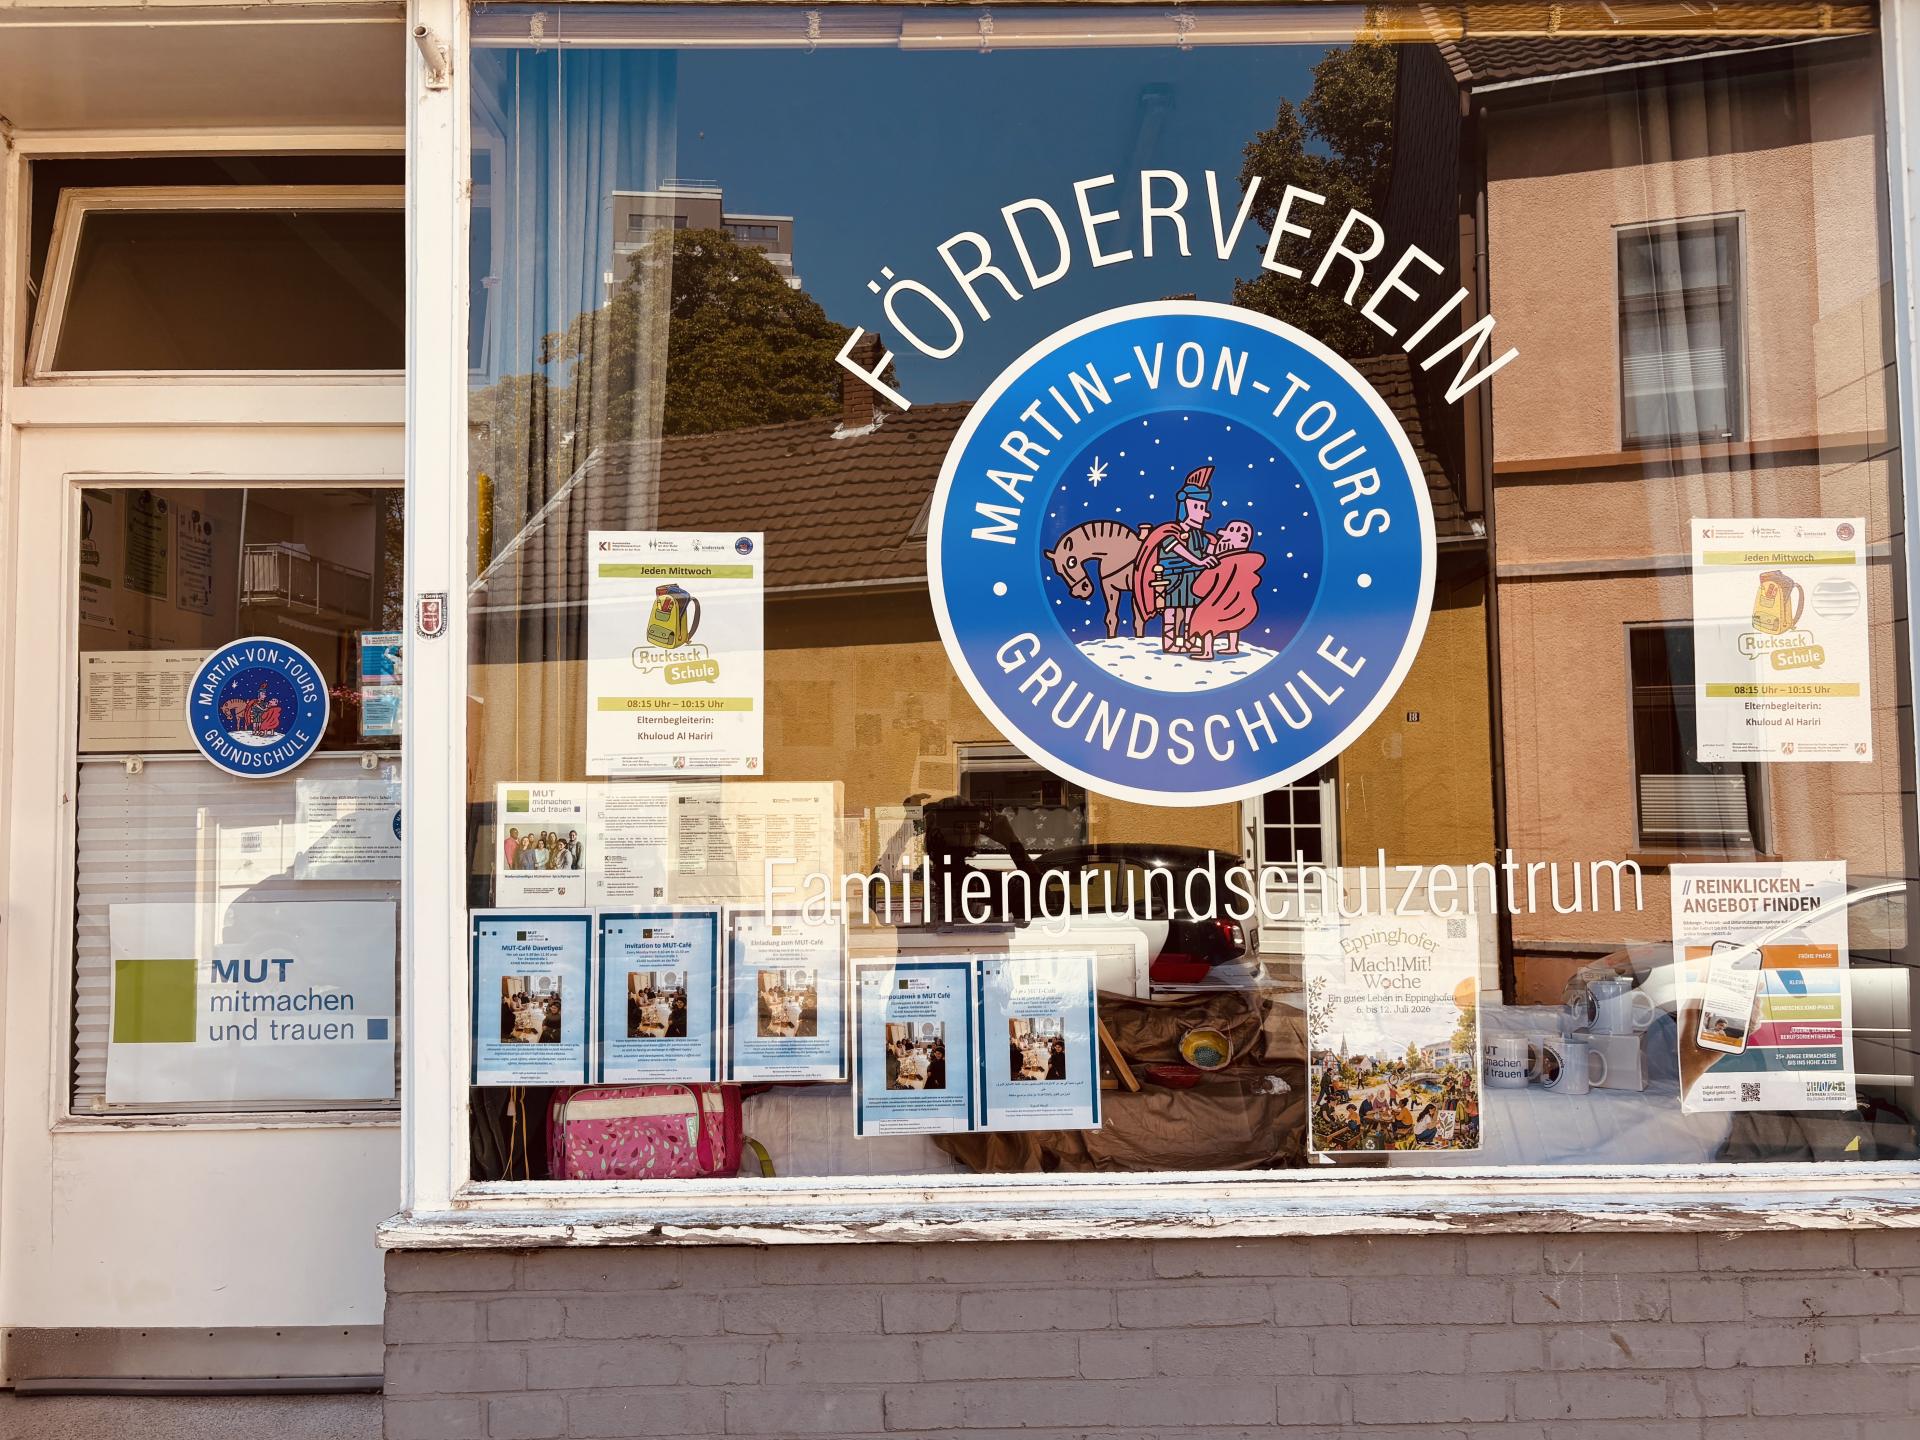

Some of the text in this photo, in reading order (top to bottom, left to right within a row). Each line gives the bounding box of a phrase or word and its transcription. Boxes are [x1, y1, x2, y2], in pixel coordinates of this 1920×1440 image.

[834, 169, 1519, 411] FÖRDERVEREIN
[970, 341, 1391, 545] MARTIN-VON-TOURS
[1743, 553, 1815, 562] Jeden Mittwoch
[640, 566, 712, 575] Jeden Mittwoch
[1745, 634, 1806, 650] Rucksack
[639, 648, 701, 664] Rucksack
[1777, 652, 1821, 666] Schule
[198, 647, 318, 706] MARTIN-VON-TOURS
[671, 665, 715, 680] Schule
[1734, 686, 1759, 695] 08:15
[1761, 686, 1778, 695] Uhr
[1788, 686, 1812, 694] 10:15
[1814, 686, 1831, 694] Uhr
[627, 700, 652, 708] 08:15
[654, 700, 671, 708] Uhr
[681, 700, 705, 708] 10:15
[708, 700, 724, 708] Uhr
[996, 632, 1368, 766] GRUNDSCHULE
[1744, 702, 1822, 712] Elternbegleiterin:
[637, 716, 714, 726] Elternbegleiterin:
[1745, 718, 1821, 726] Khuloud Al Hariri
[637, 732, 713, 740] Khuloud Al Hariri
[204, 729, 310, 767] GRUNDSCHULE
[532, 790, 555, 798] MUT
[532, 805, 572, 813] und trauen
[763, 848, 1644, 938] Familiengrundschulzentrum
[1696, 878, 1800, 894] REINKLICKEN
[1683, 897, 1821, 912] ANGEBOT FINDEN
[751, 939, 780, 947] Einladung
[1339, 928, 1440, 954] Eppinghofer
[210, 958, 294, 983] MUT
[1363, 973, 1422, 989] Woche
[210, 987, 354, 1012] mitmachen
[1328, 993, 1456, 1004] Ein gutes Leben in Eppinghofen
[1356, 1005, 1431, 1013] 6. bis 12. Juli 2026
[209, 1017, 354, 1041] und trauen
[1491, 1069, 1522, 1078] trauen
